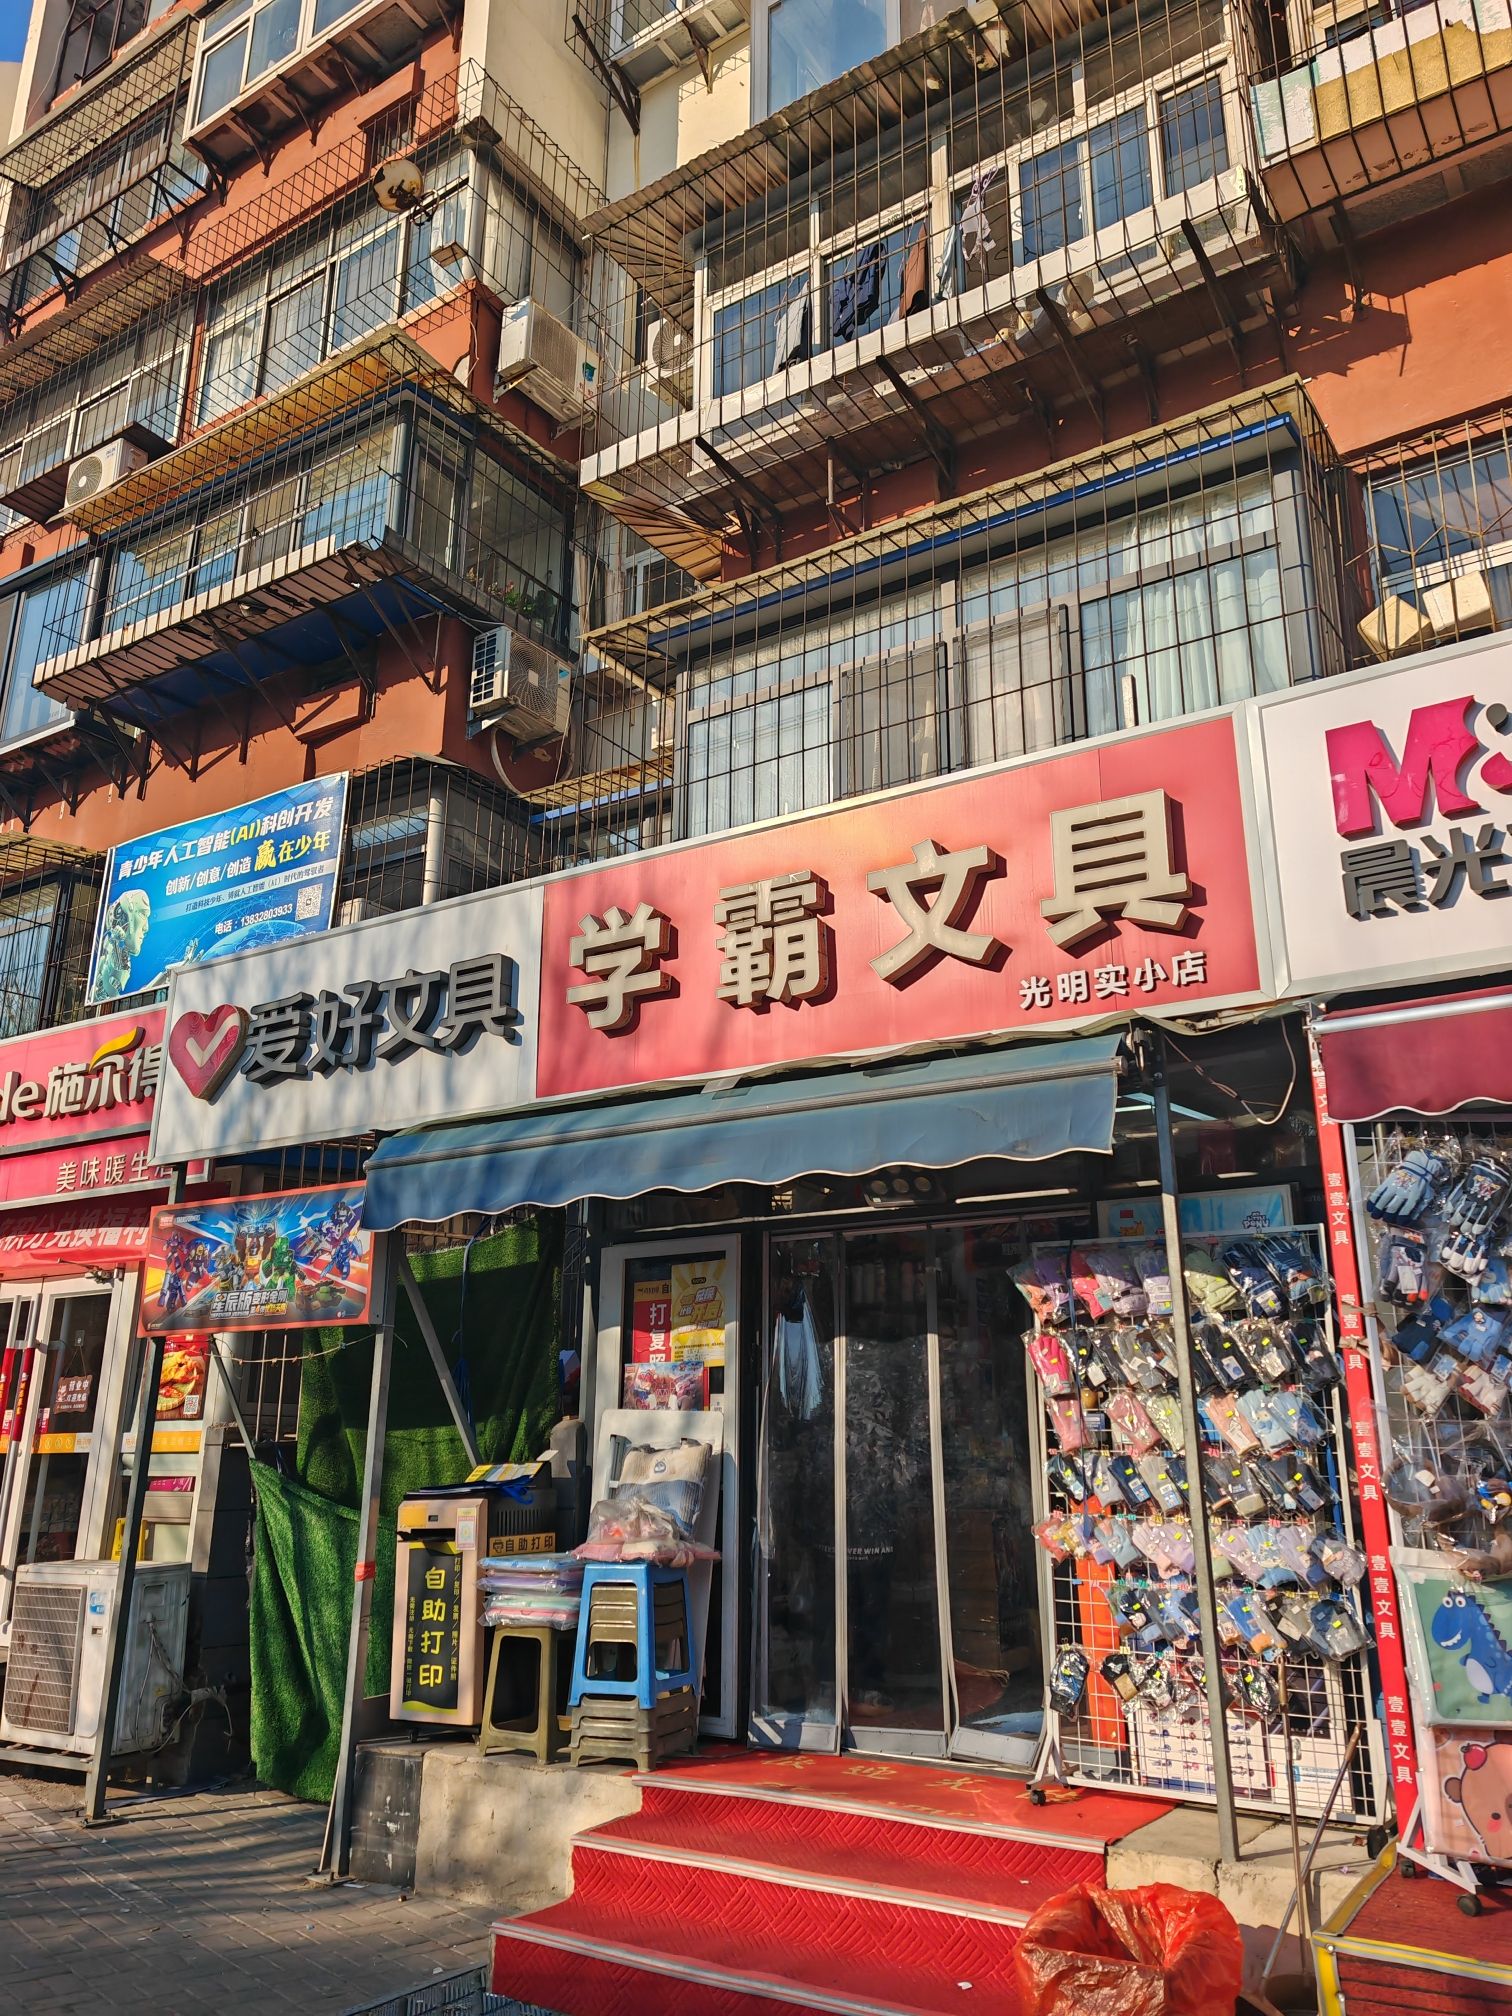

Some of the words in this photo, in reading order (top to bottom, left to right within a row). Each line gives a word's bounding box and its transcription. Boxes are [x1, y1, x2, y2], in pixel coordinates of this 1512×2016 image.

[118, 796, 334, 880] 青少年人工智能(AI)科创开发
[165, 856, 251, 896] 创新/创意/创造
[254, 829, 331, 871] 赢在少年
[1340, 822, 1512, 918] 晨光
[566, 788, 1199, 1033] 学霸文具
[241, 953, 520, 1086] 爱好文具
[1018, 950, 1207, 1010] 光明实小店
[44, 1030, 162, 1118] 施尔得
[1327, 1172, 1350, 1245] 壹壹文具
[1341, 1294, 1364, 1370] 壹壹具
[1355, 1421, 1379, 1501] 壹壹文具
[505, 1535, 553, 1552] 自助打印
[419, 1566, 447, 1688] 自助打印
[1371, 1555, 1396, 1640] 壹壹文具
[1388, 1696, 1413, 1784] 壹壹文具
